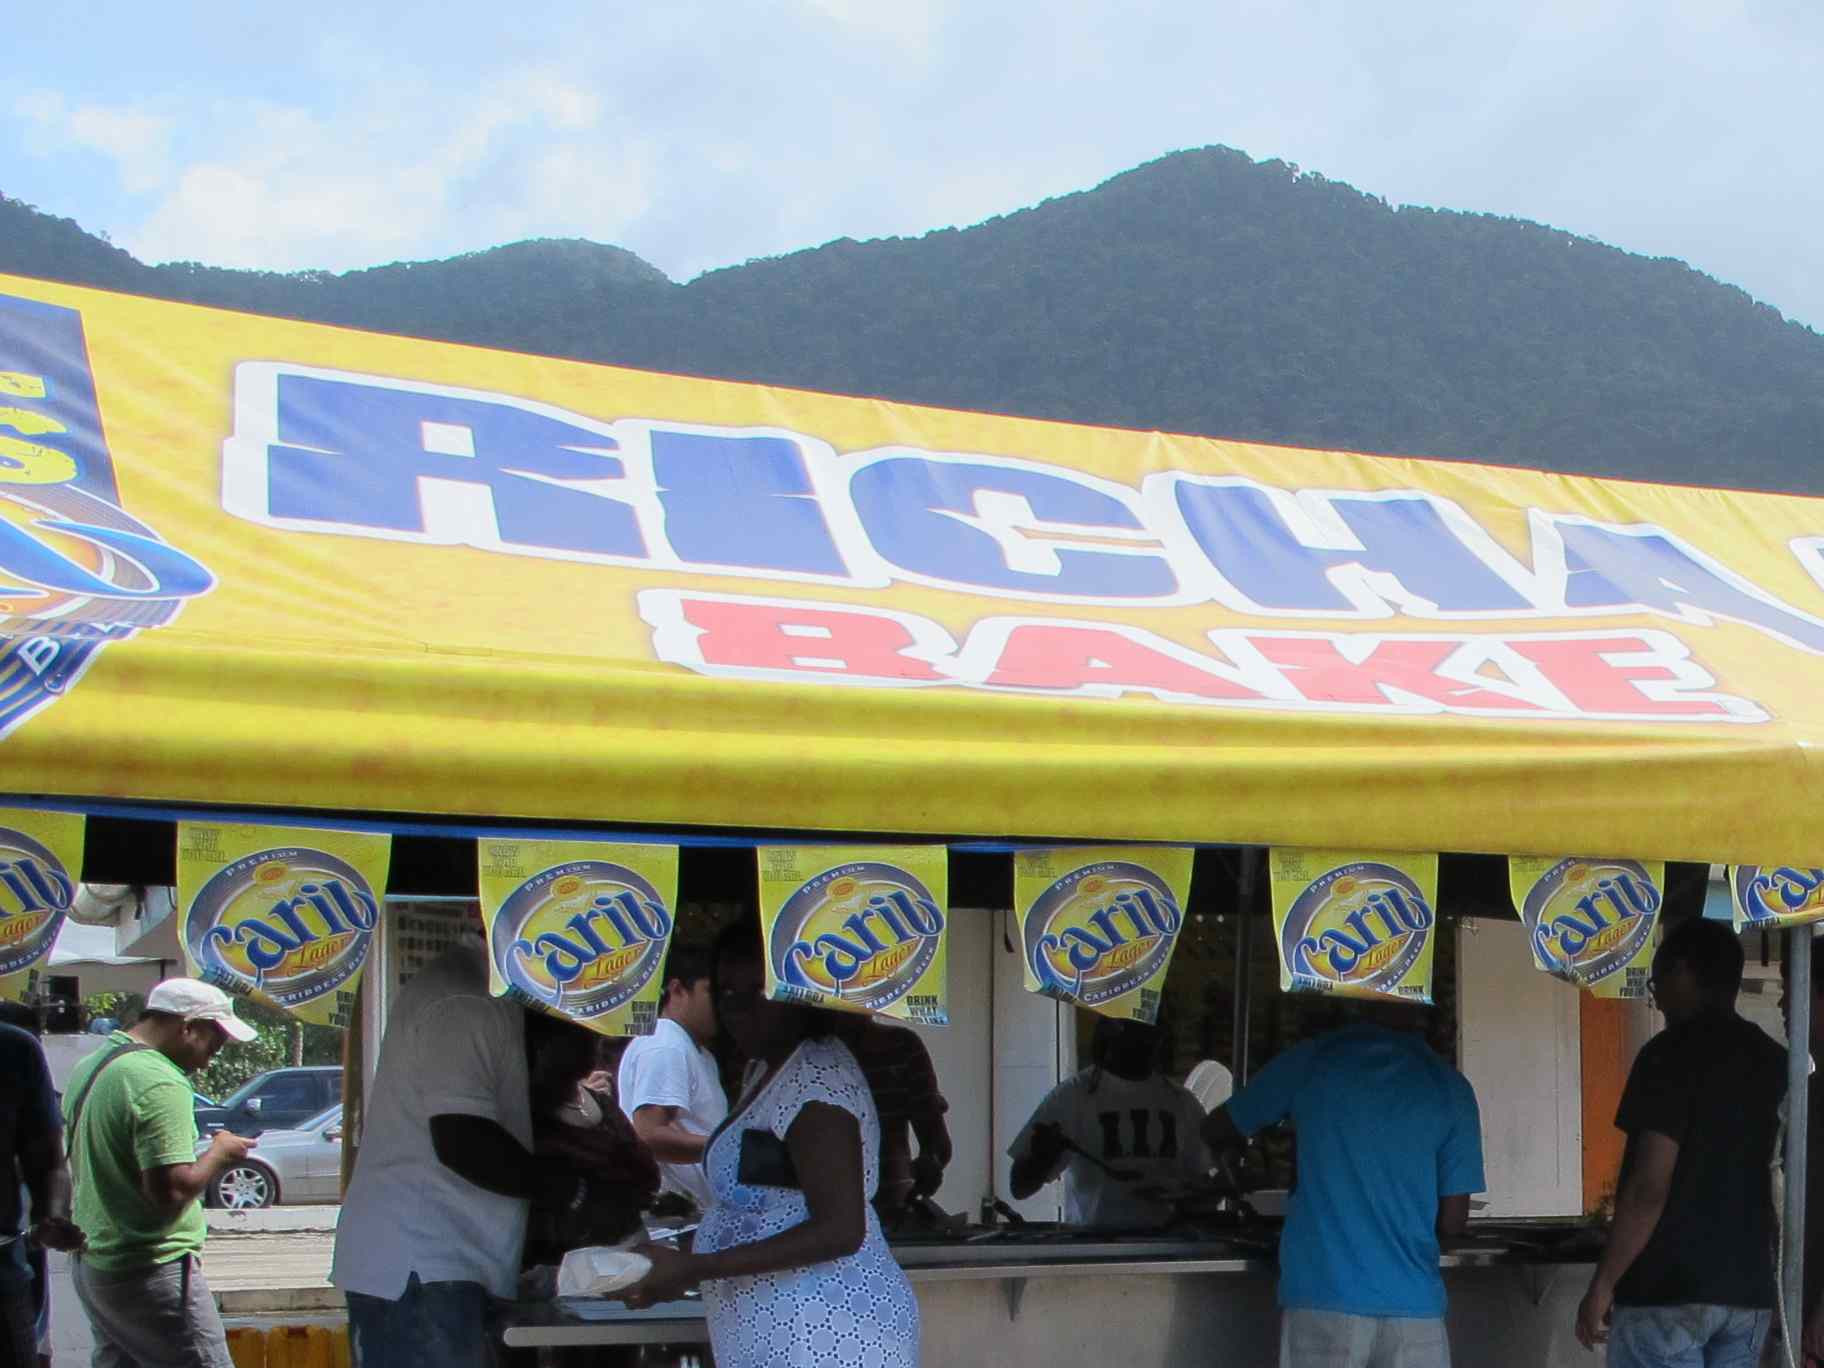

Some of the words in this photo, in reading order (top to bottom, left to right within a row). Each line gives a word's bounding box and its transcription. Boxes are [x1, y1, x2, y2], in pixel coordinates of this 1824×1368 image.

[640, 588, 1770, 724] BAKE
[225, 850, 299, 877] PREMIUM
[1544, 858, 1576, 882] PREM
[200, 879, 379, 990] Carib
[504, 892, 674, 1008] Carib
[784, 890, 945, 997] Carib
[1035, 889, 1181, 1000] Carib
[1293, 888, 1432, 983] Carib
[1534, 873, 1662, 976] Carib
